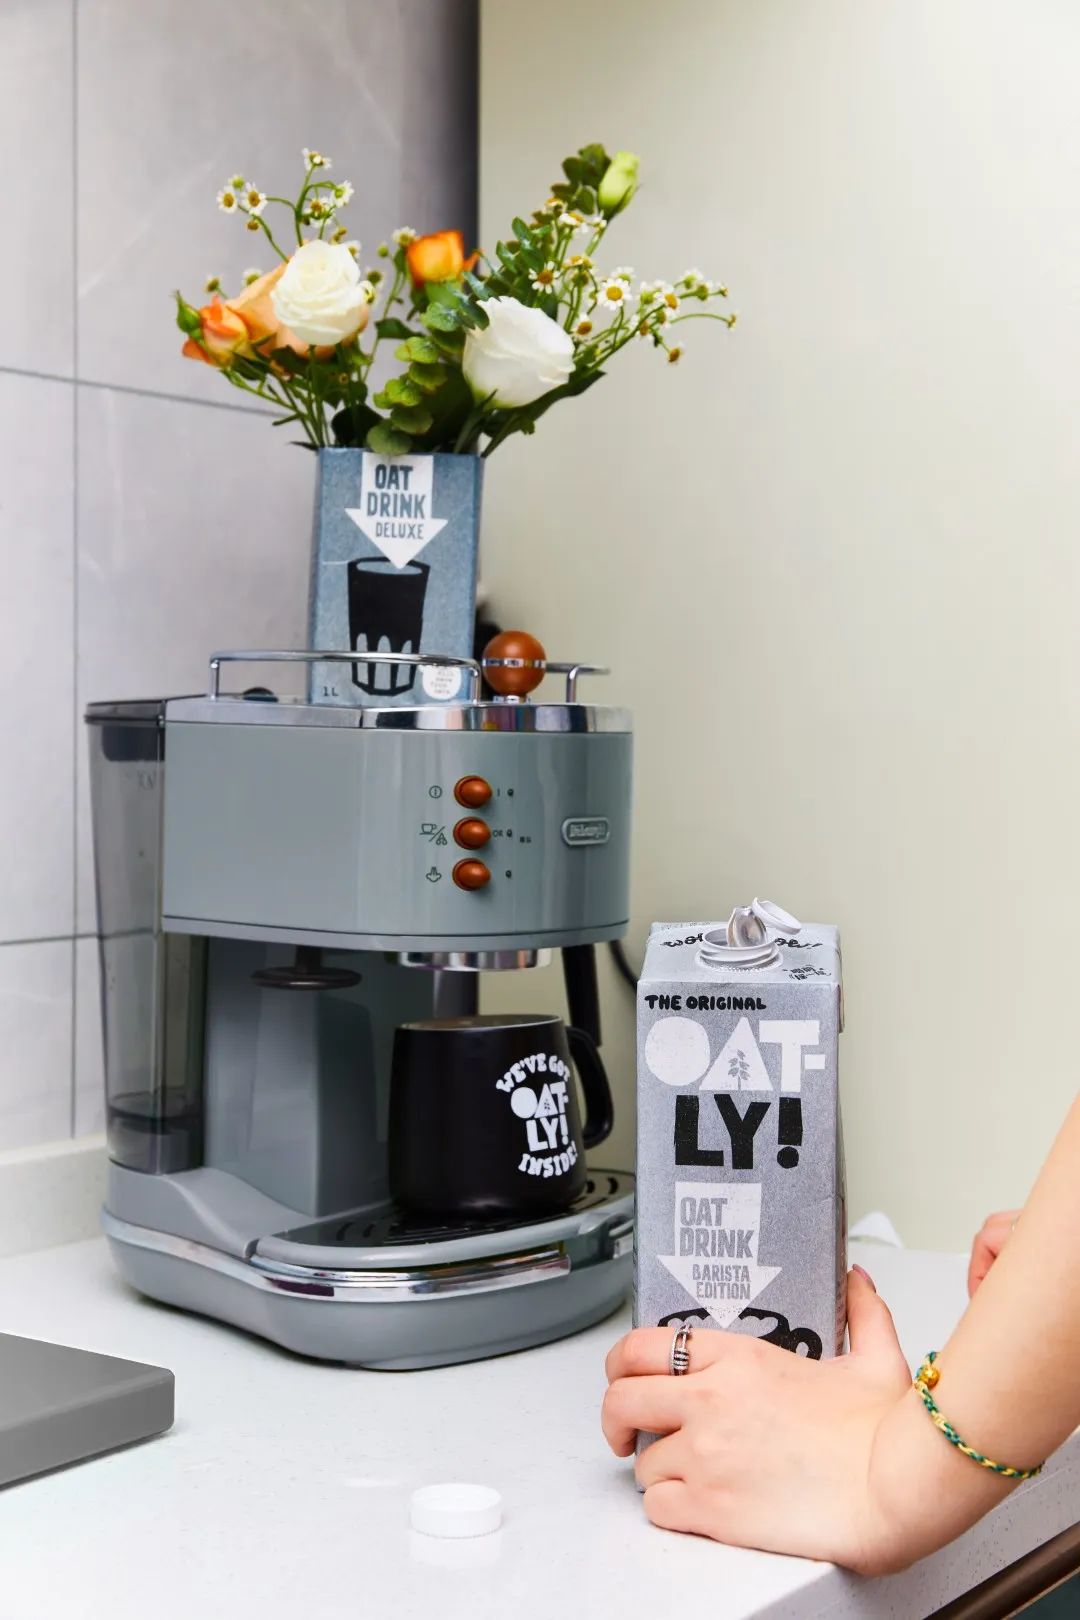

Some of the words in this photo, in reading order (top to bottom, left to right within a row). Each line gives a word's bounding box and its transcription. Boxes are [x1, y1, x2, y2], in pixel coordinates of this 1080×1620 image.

[375, 463, 413, 490] OAT
[367, 491, 426, 519] DRINK
[375, 521, 425, 540] DELUXE
[644, 994, 682, 1011] THE
[686, 994, 767, 1011] ORIGINAL
[496, 1053, 547, 1093] WE'VE
[548, 1055, 570, 1082] GOT
[526, 1114, 569, 1152] LY!
[674, 1093, 803, 1170] LY!
[680, 1196, 728, 1227] OAT
[679, 1227, 754, 1258] DRINK
[692, 1264, 751, 1283] BARISTA
[696, 1281, 751, 1300] EDITION
